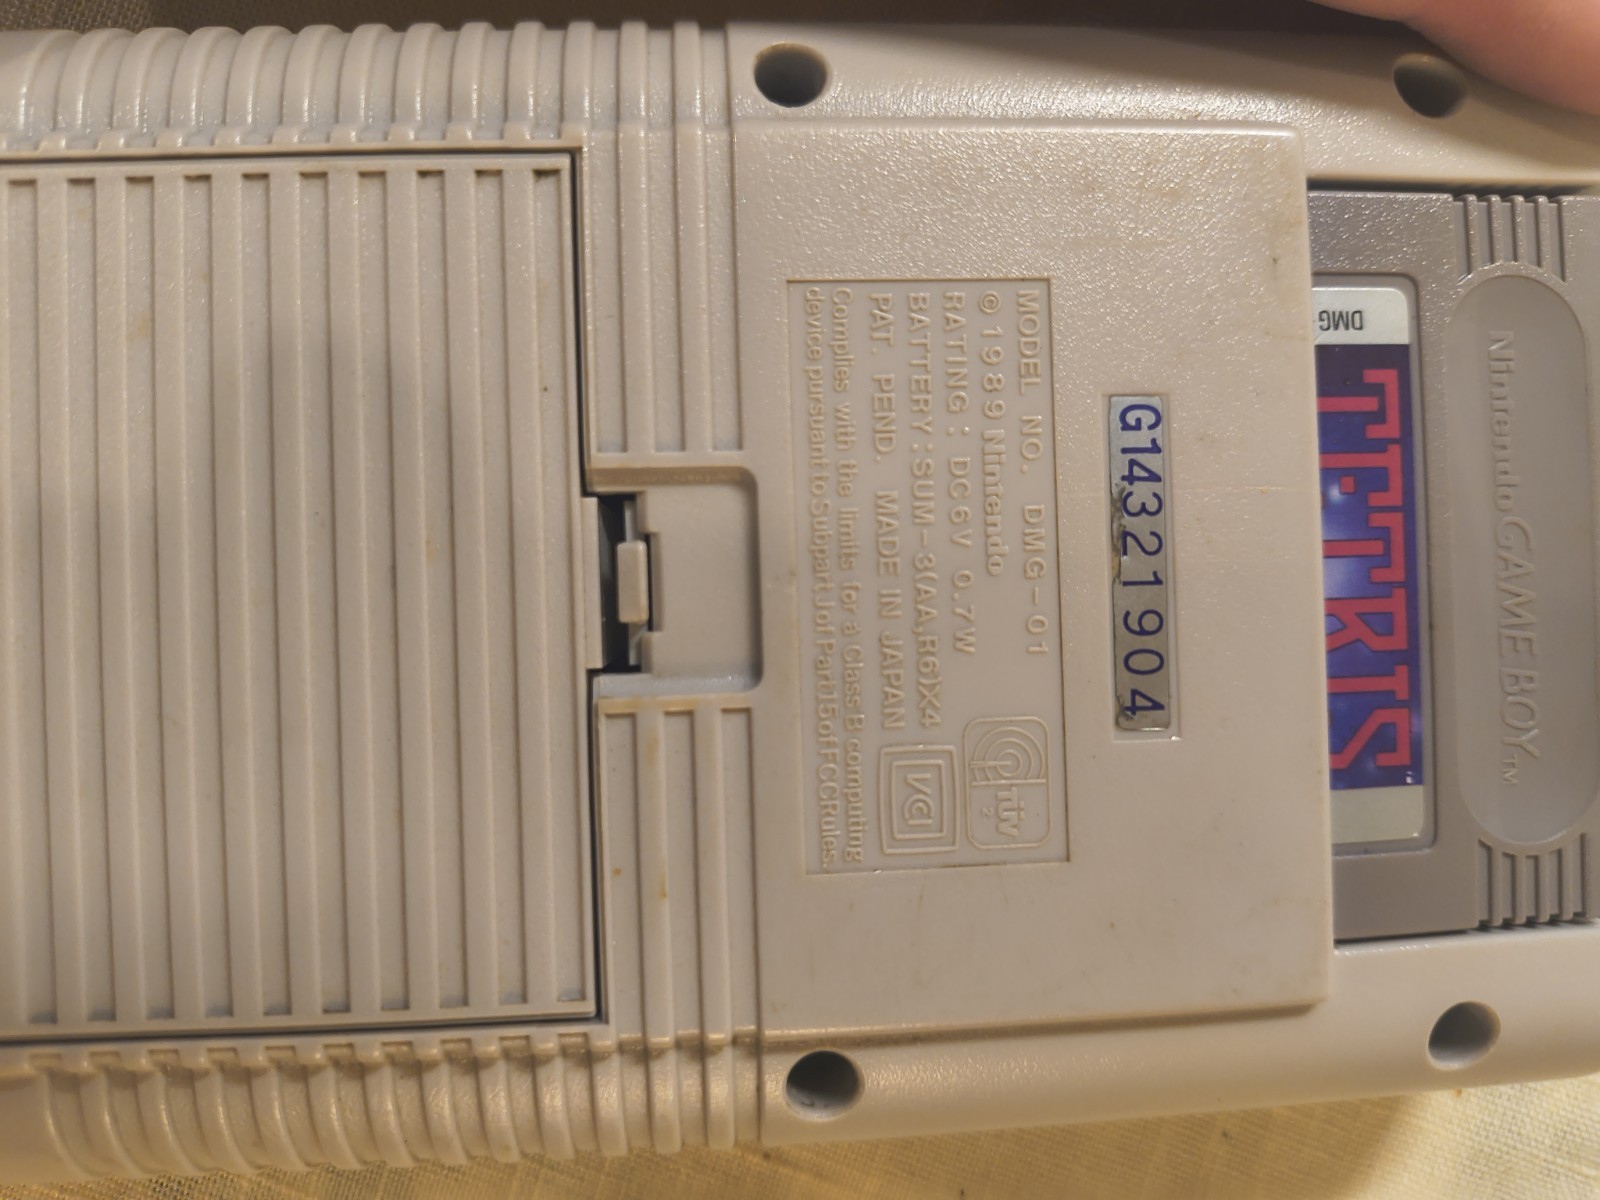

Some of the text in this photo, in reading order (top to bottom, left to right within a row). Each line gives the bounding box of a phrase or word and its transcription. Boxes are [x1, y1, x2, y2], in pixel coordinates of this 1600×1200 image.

[803, 287, 825, 361] device
[1317, 310, 1364, 331] DMG
[802, 367, 829, 469] pursuant
[1017, 289, 1047, 655] MODEL NO. DMG-01
[1488, 330, 1520, 512] Nintendo
[810, 473, 829, 495] to
[869, 293, 904, 729] PAT. PEND. MADE IN JAPAN
[981, 429, 1008, 576] Nintendo
[808, 499, 833, 593] Subpart
[829, 287, 866, 863] Complies with the limits for a Class B computing
[1118, 402, 1166, 718] G14321904
[1316, 368, 1411, 770] TETRIS
[1495, 515, 1538, 657] GAME
[952, 570, 974, 655] 0.7W
[1501, 667, 1541, 760] BOY
[997, 787, 1023, 838] TÜV
